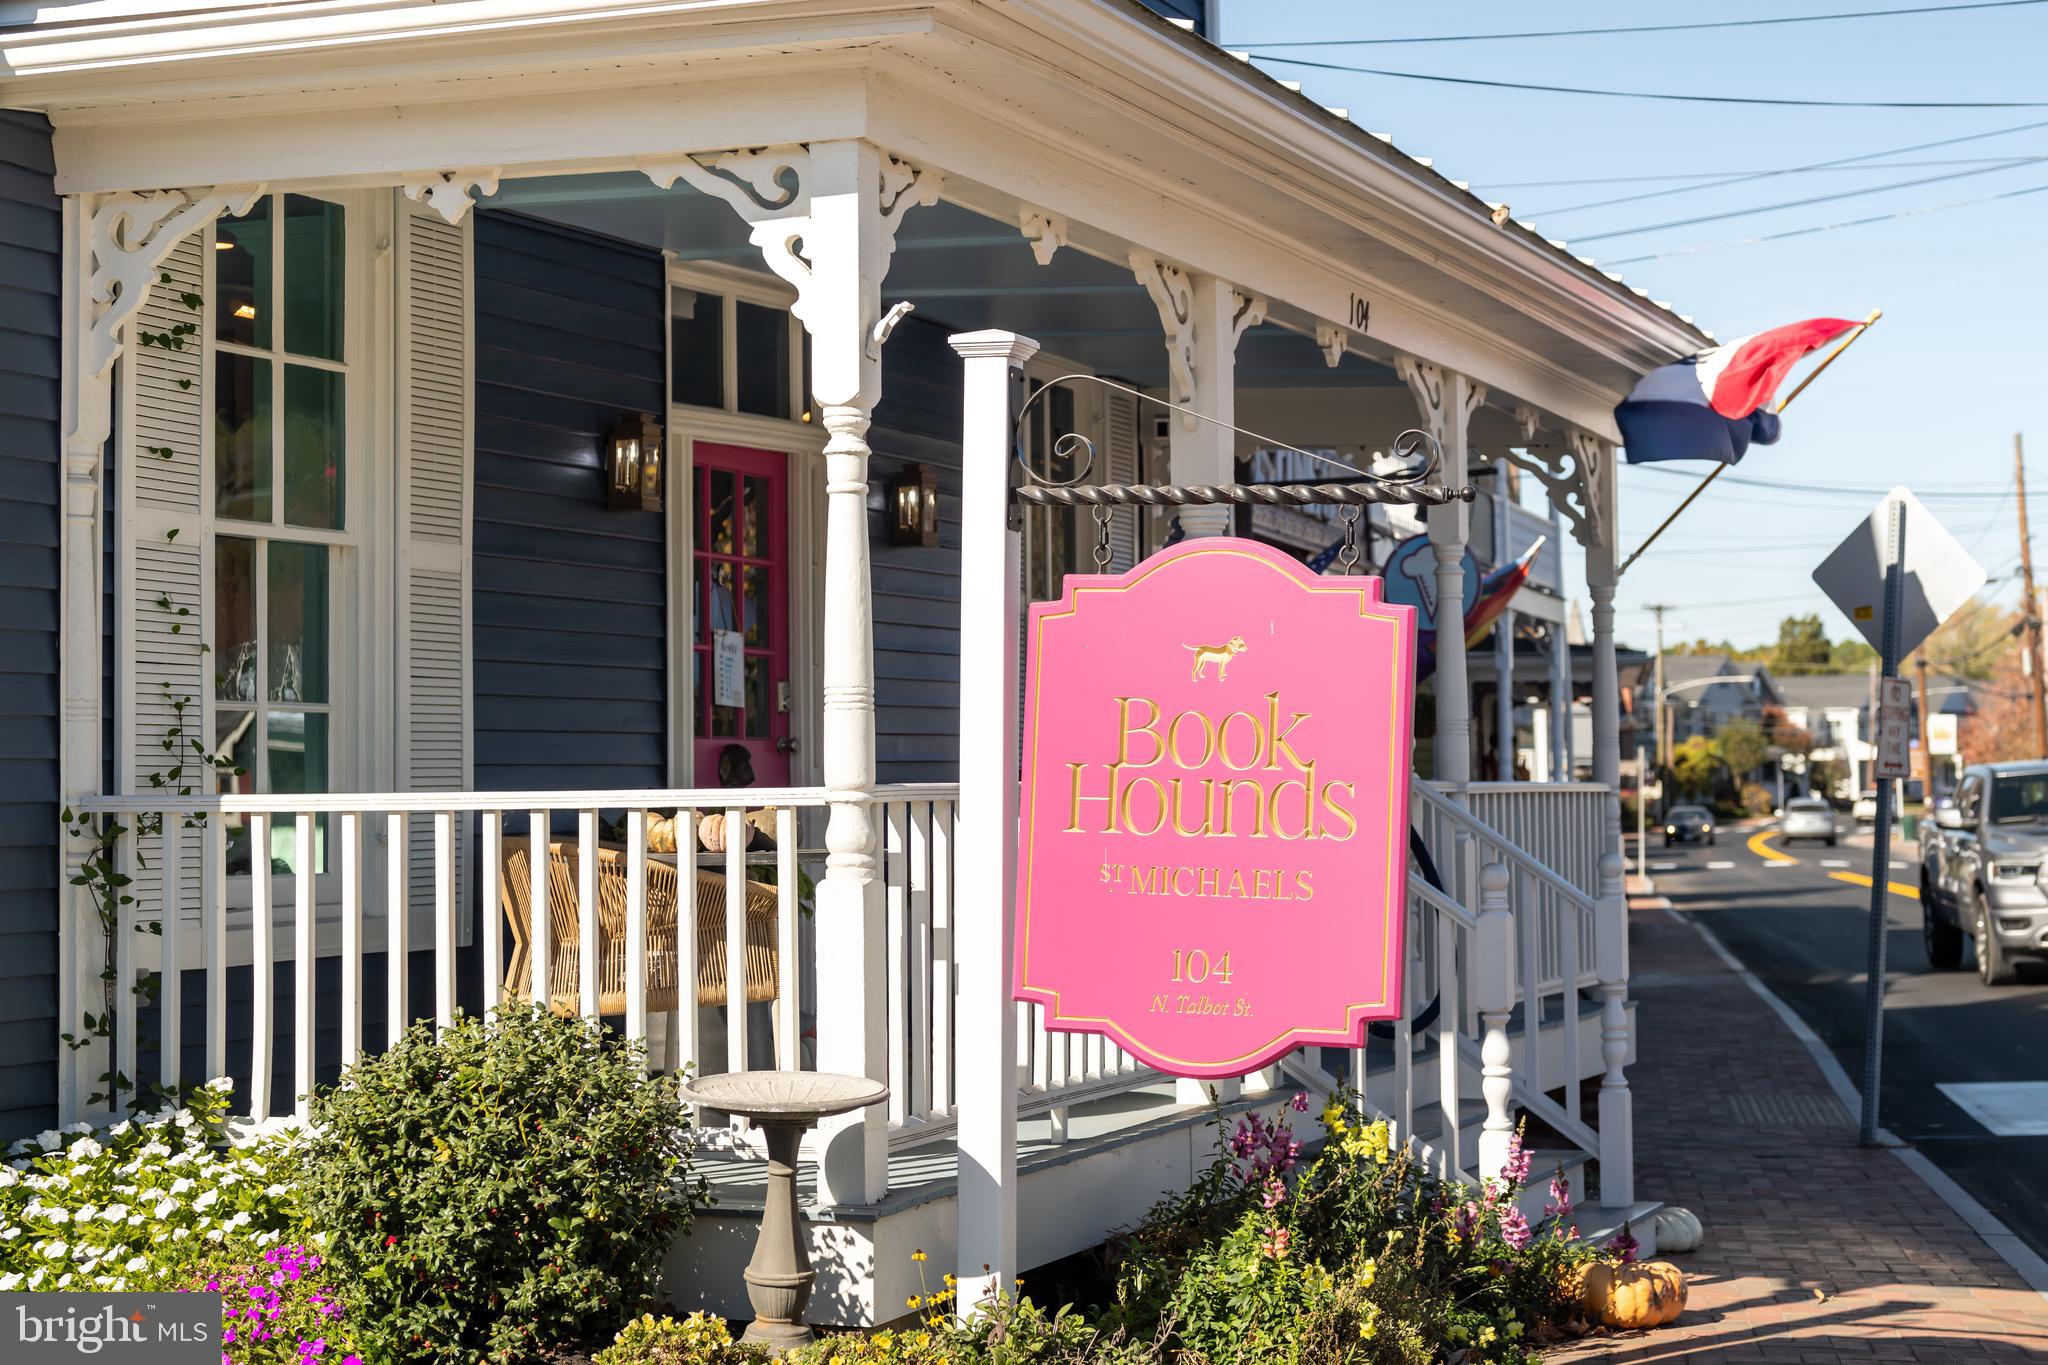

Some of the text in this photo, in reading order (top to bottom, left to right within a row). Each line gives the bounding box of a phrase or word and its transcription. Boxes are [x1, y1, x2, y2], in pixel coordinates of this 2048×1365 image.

[1349, 292, 1370, 333] 104
[1112, 690, 1315, 772] Book
[1062, 759, 1357, 841] Hounds
[1128, 864, 1315, 902] MICHAELS
[1171, 949, 1234, 984] 104
[1149, 993, 1255, 1018] N. Talbot St.
